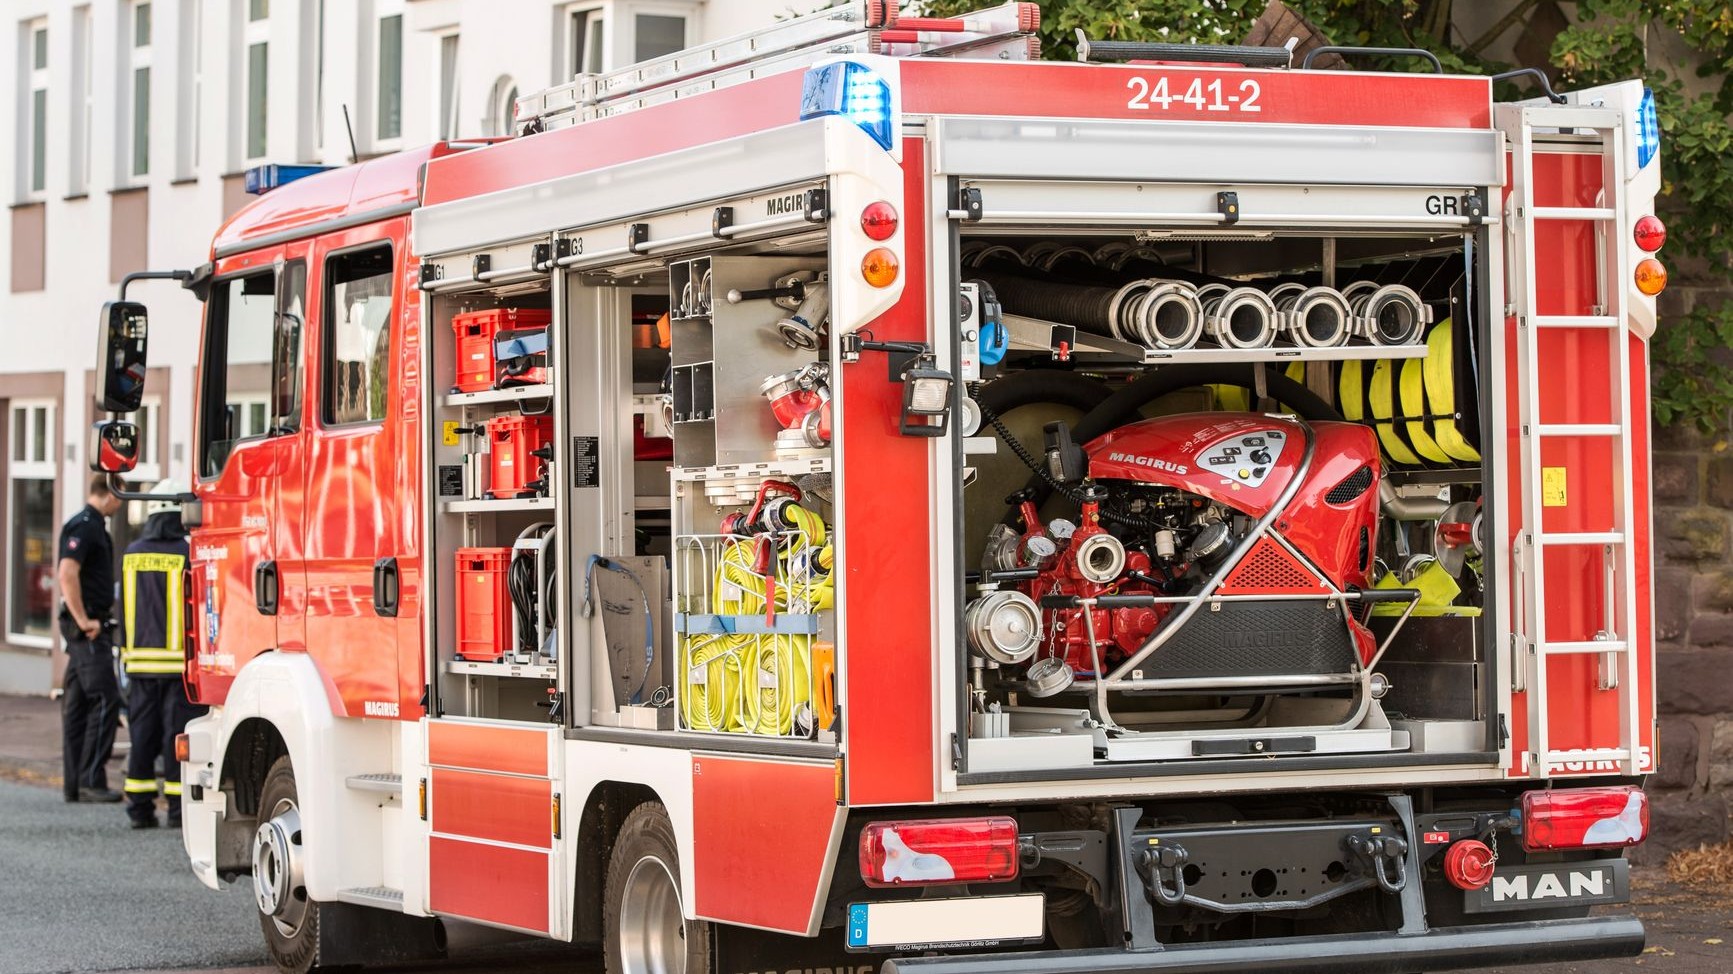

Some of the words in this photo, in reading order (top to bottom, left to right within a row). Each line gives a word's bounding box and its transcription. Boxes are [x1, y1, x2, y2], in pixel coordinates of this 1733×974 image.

[1127, 76, 1261, 112] 24-41-2
[767, 193, 807, 216] MAGIR
[1425, 195, 1458, 215] GR
[571, 237, 583, 256] G3
[435, 264, 445, 280] G1
[1109, 452, 1188, 475] MAGIRUS
[365, 700, 399, 717] MAGIRUS
[1493, 870, 1603, 901] MAN
[855, 929, 862, 939] D
